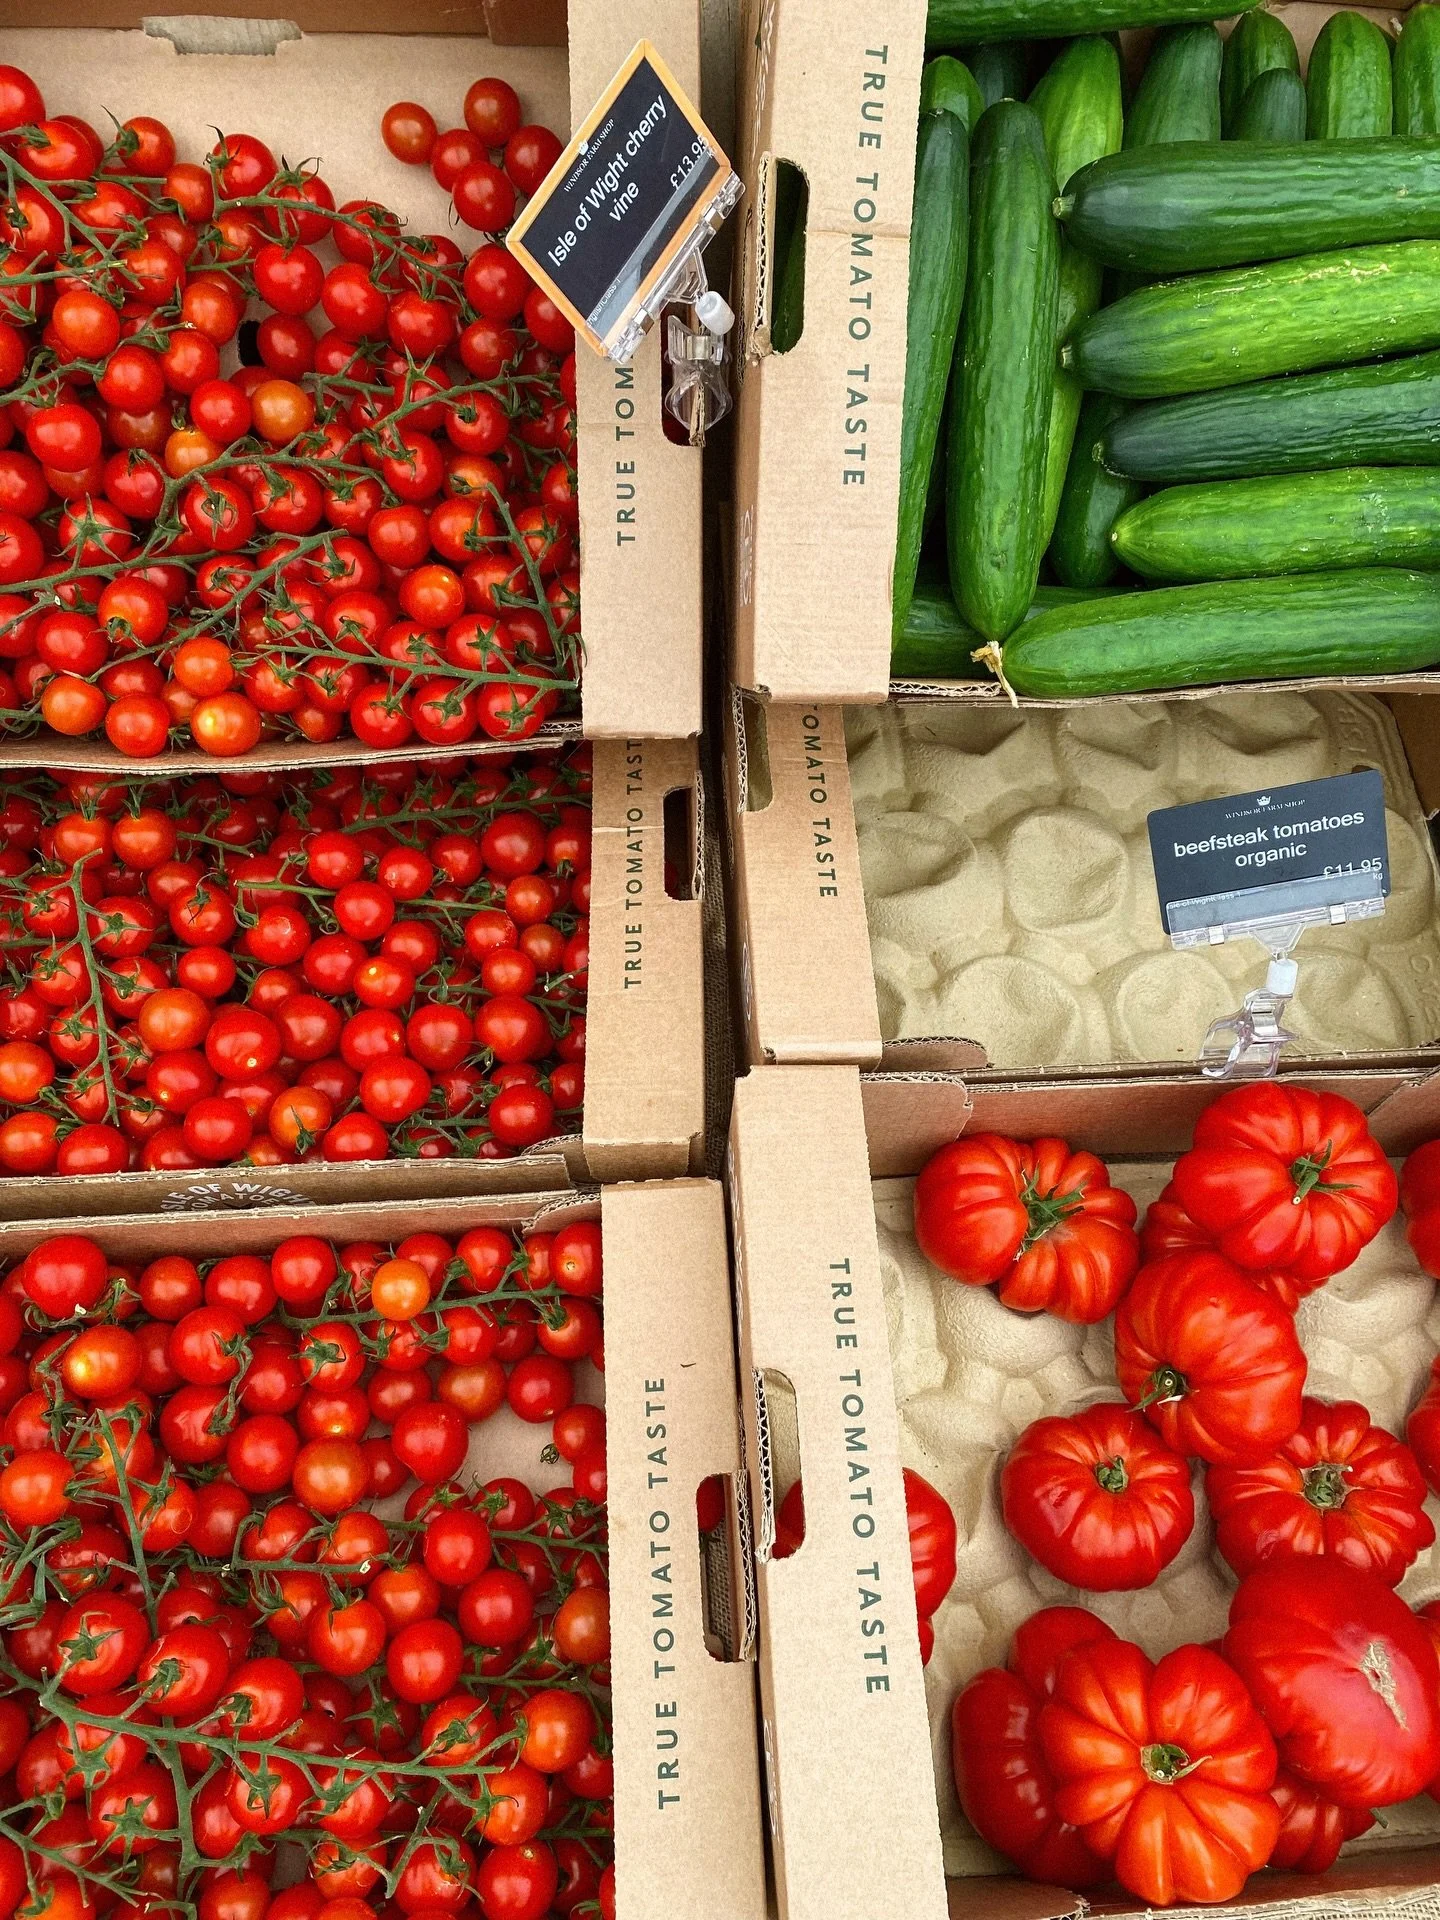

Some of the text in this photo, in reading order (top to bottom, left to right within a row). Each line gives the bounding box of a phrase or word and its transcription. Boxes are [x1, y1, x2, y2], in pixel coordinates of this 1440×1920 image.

[547, 94, 667, 266] Isle of Wight cherry
[564, 119, 615, 192] WINDSOR FARM SHOP
[609, 181, 640, 222] vine
[670, 132, 710, 191] £13.95
[843, 45, 888, 485] TRUE TOMATO TASTE
[615, 354, 635, 546] TRUE TOM
[802, 705, 837, 897] OMATO TASTE
[1174, 811, 1365, 858] beefsteak tomatoes
[1225, 808, 1260, 819] WINDSOR
[1284, 799, 1305, 808] SHOP
[1235, 842, 1308, 867] organic
[625, 740, 643, 988] TRUE TOMATO TAST
[160, 1192, 194, 1210] SLE
[188, 1183, 221, 1195] OF
[830, 1258, 890, 1693] TRUE TOMATO TASTE
[645, 1379, 680, 1809] TRUE TOMATO TASTE
